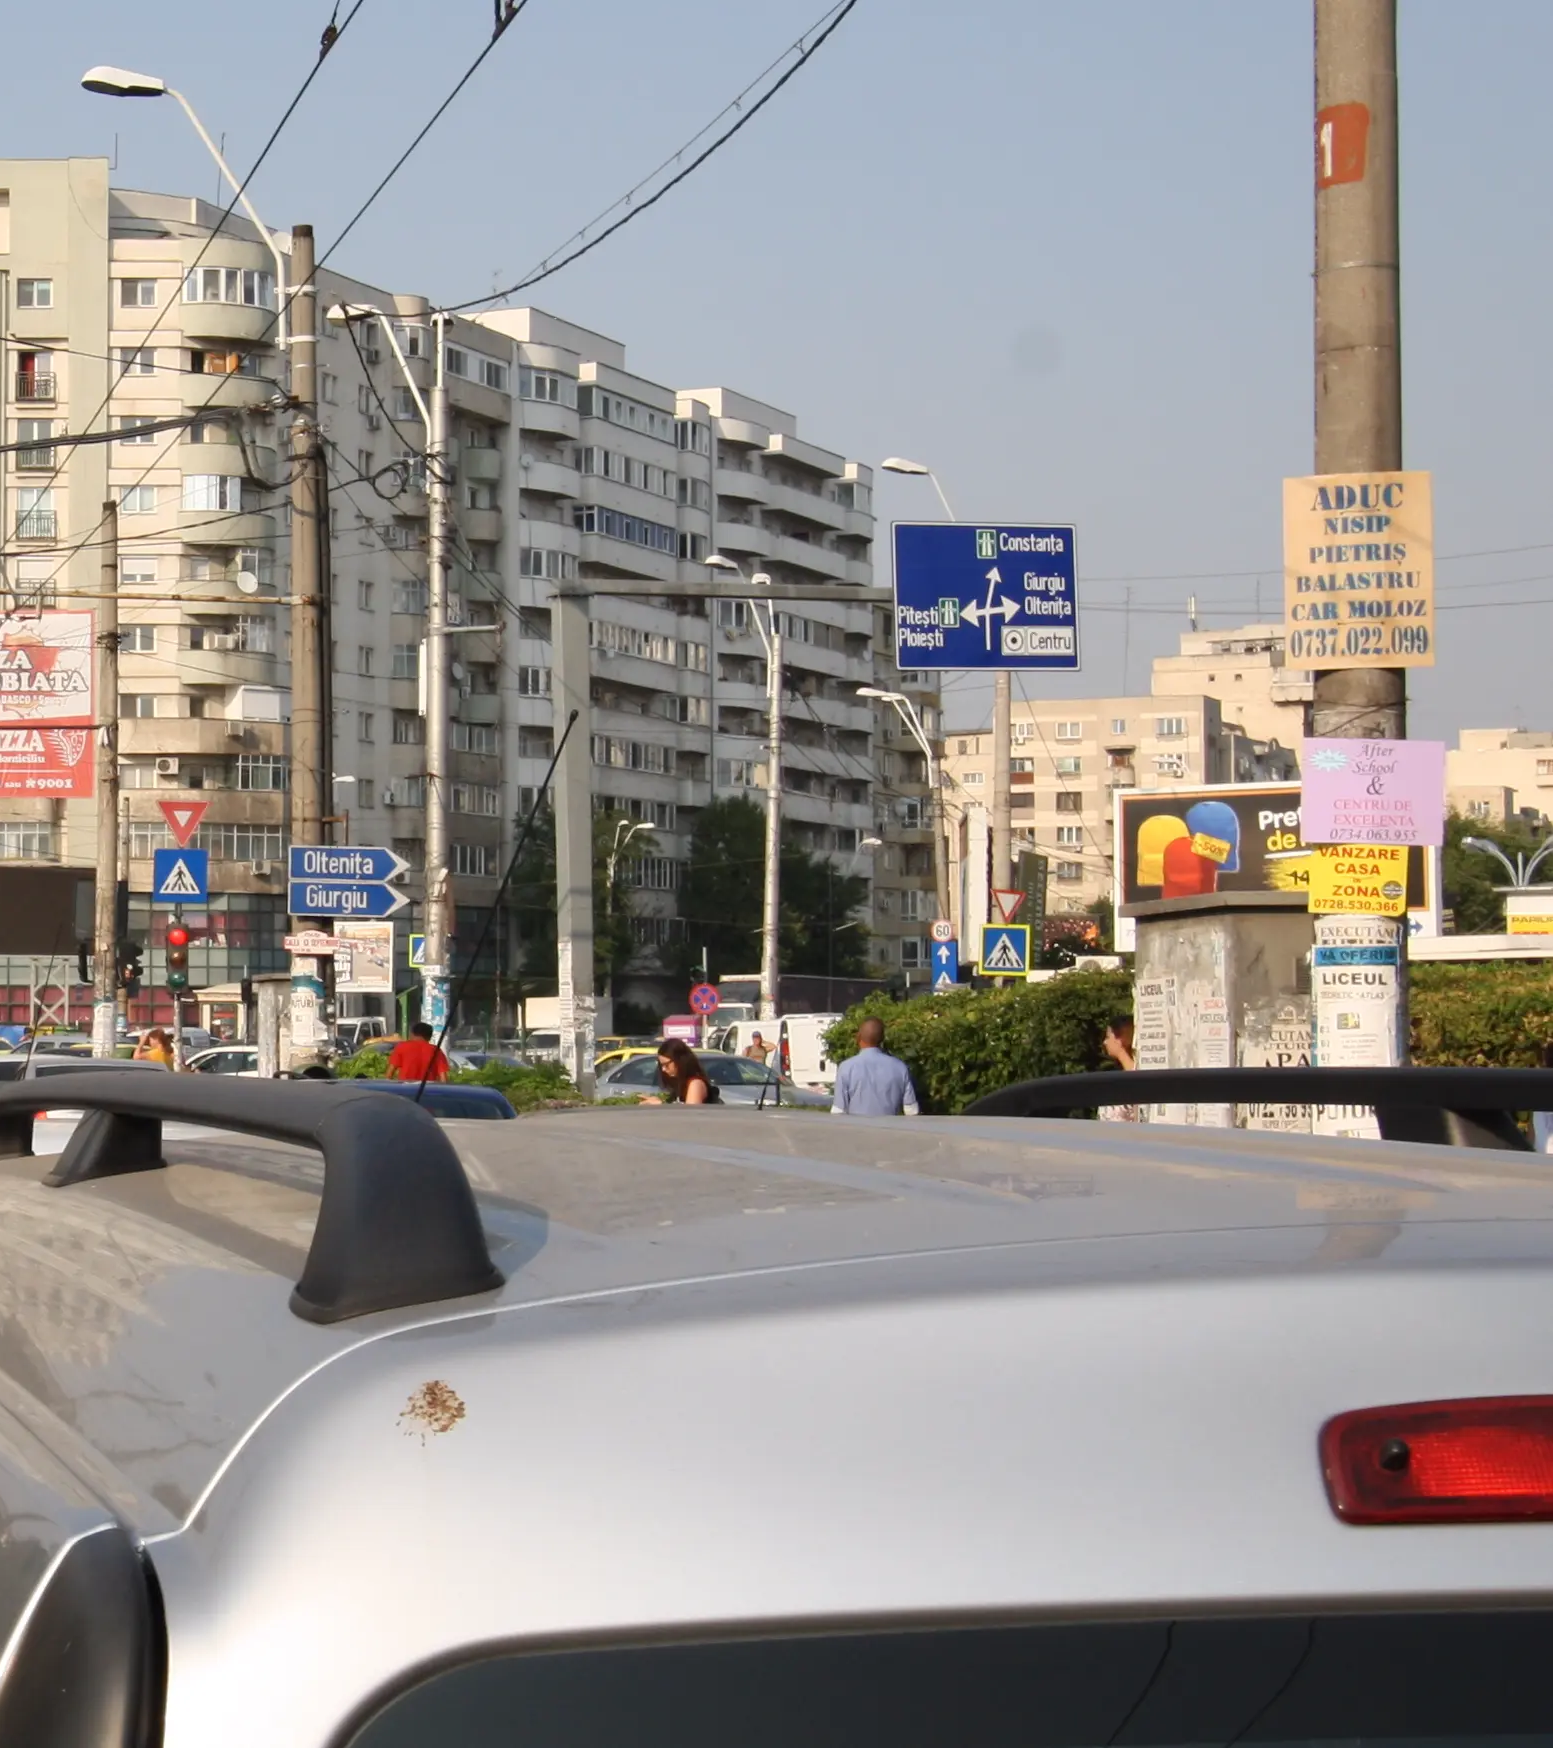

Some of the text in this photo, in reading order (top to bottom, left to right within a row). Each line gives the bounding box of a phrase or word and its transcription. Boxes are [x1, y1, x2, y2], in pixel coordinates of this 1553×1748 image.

[1310, 483, 1404, 512] ADUC
[1324, 514, 1392, 535] NISIP
[999, 532, 1064, 556] Constanța
[1024, 572, 1066, 596] Giurgiu
[1296, 571, 1421, 593] BALASTRU
[898, 606, 939, 628] Pitești
[1024, 596, 1072, 619] Oltenița
[1291, 599, 1427, 622] CAR MOLOZ
[898, 628, 944, 650] Ploiești
[1029, 632, 1072, 650] Centru
[1290, 624, 1429, 658] 0737.022.099
[1357, 743, 1395, 760] After
[1351, 760, 1398, 775] School
[1366, 775, 1386, 796] &
[1333, 799, 1413, 812] CENTRU DE
[1258, 806, 1303, 831] Pre
[1266, 829, 1297, 851] de
[1329, 828, 1419, 842] 0734.063.955
[303, 850, 374, 879] Oltenița
[1334, 862, 1381, 876] CASA
[305, 885, 368, 914] Giurgiu
[1332, 884, 1381, 898] ZONA
[1314, 899, 1399, 912] 0728.530.366
[935, 924, 950, 936] 60
[1322, 972, 1388, 986] LICEUL
